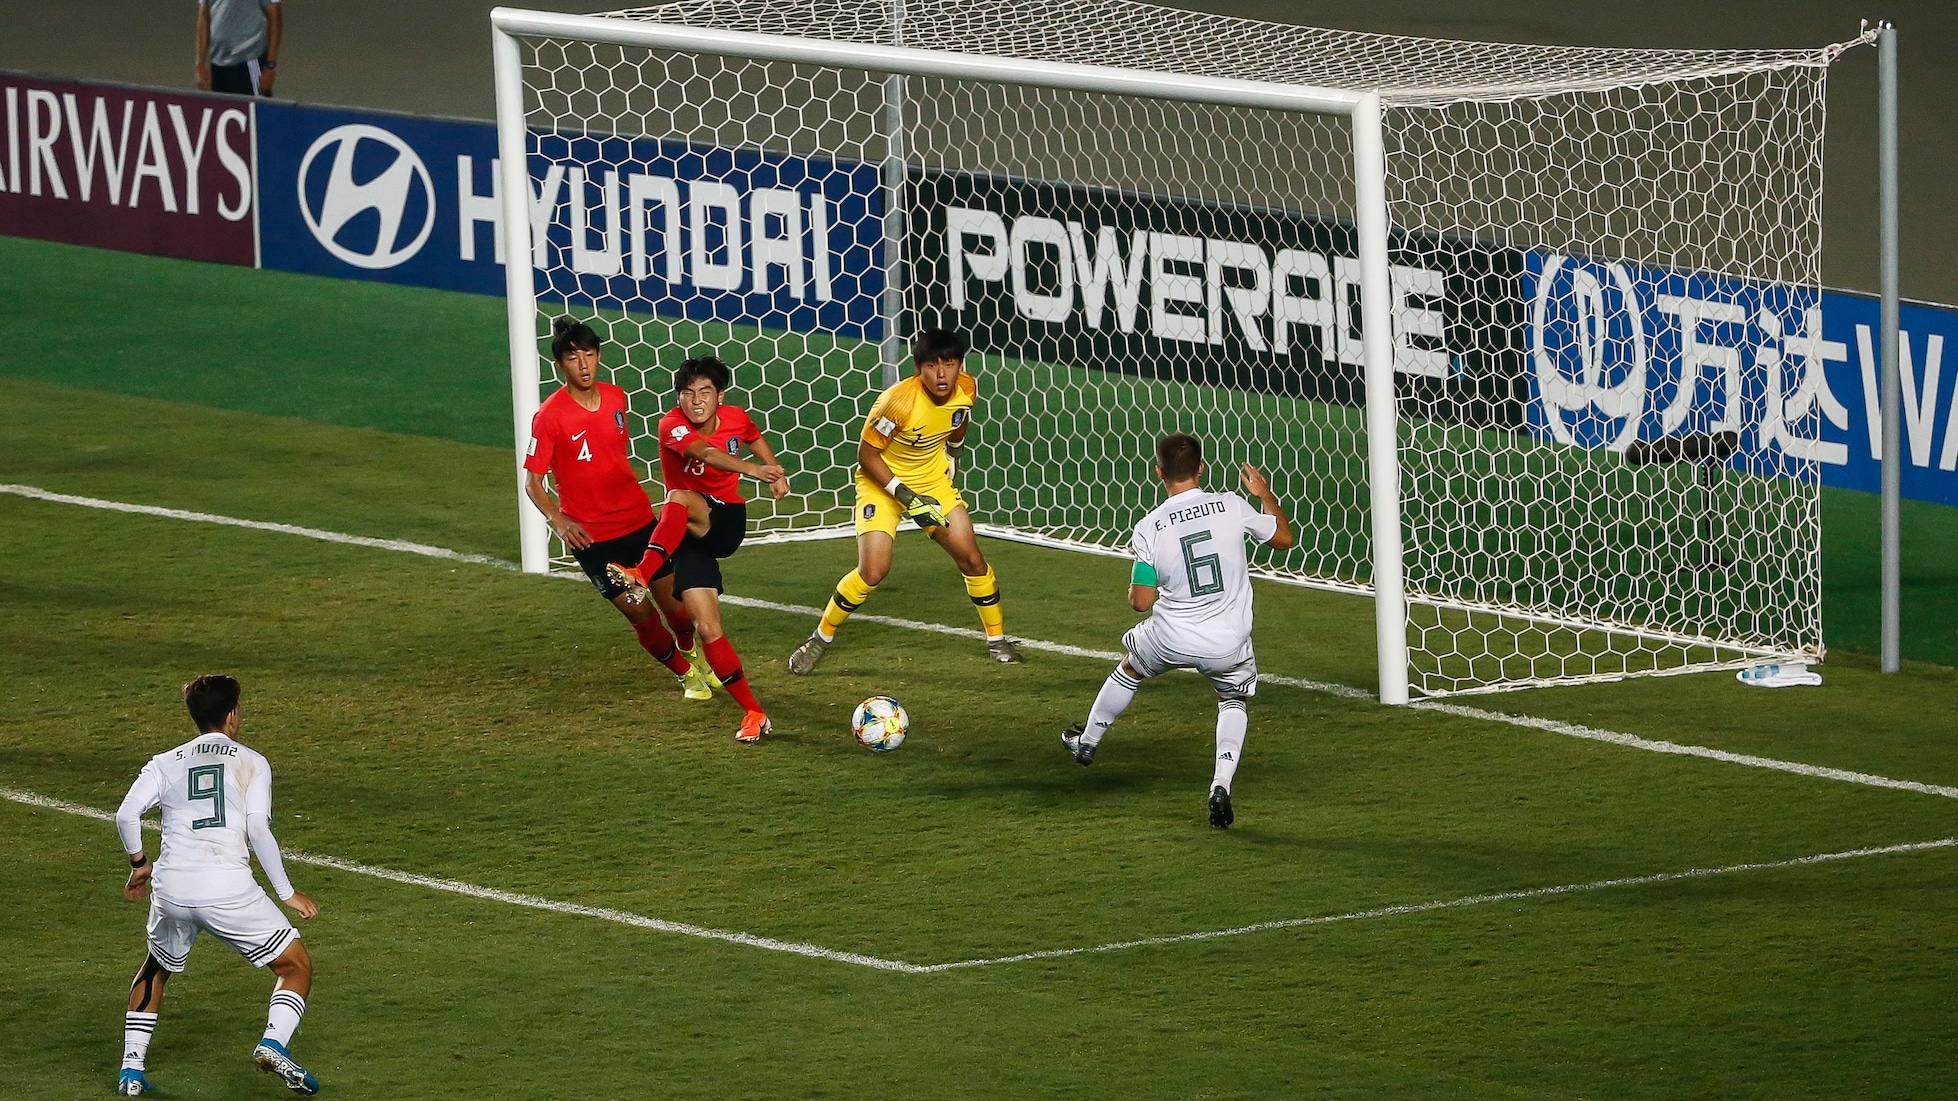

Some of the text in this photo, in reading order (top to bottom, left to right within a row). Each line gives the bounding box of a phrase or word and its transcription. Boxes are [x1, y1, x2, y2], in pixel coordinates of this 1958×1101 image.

[457, 154, 831, 302] HYUNDAI
[945, 206, 1449, 379] POWERADE
[1656, 292, 1849, 466] 万达
[576, 438, 593, 462] 4
[1154, 519, 1167, 532] E.
[1179, 529, 1225, 598] 6
[175, 750, 186, 762] S.
[188, 763, 226, 830] 9
